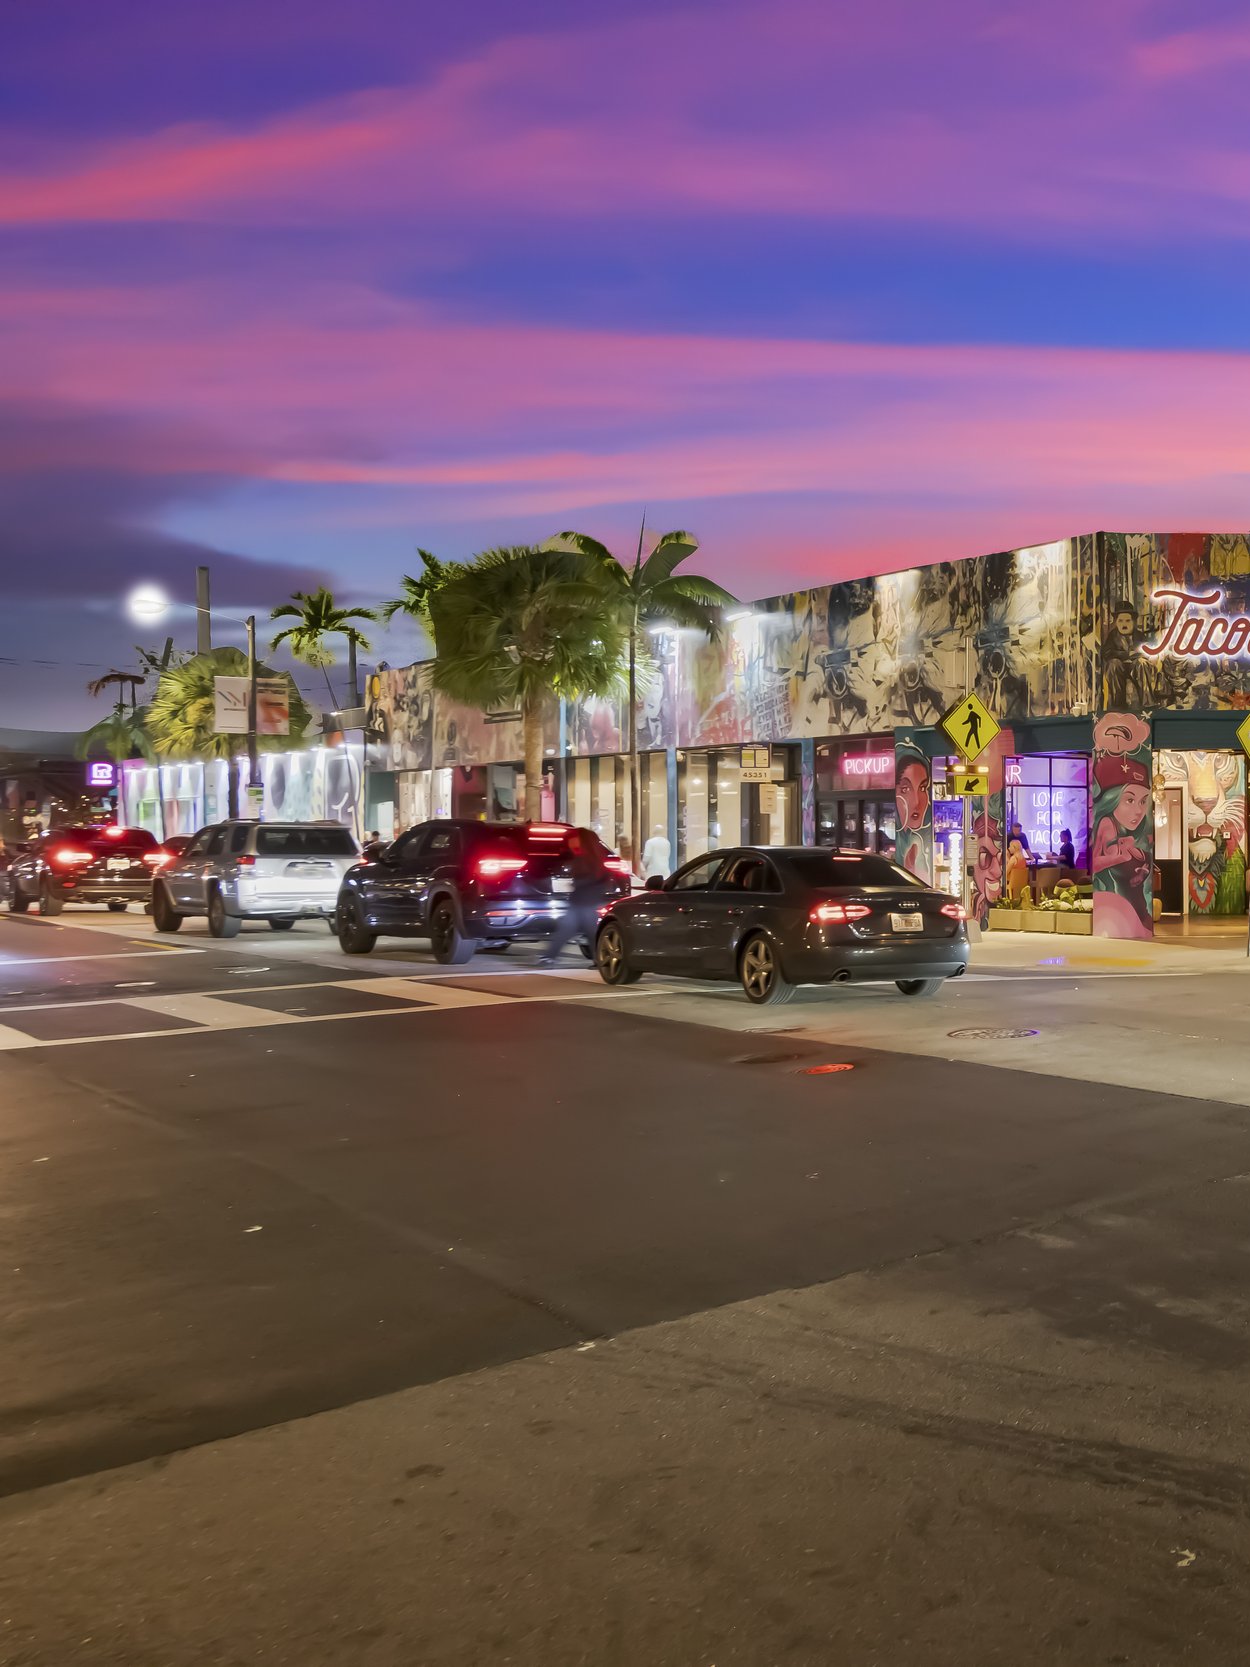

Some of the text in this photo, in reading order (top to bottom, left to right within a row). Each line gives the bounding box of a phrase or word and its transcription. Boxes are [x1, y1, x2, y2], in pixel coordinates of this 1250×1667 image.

[844, 756, 890, 775] PICKUP
[1032, 791, 1064, 807] LOVE
[1036, 811, 1062, 825] FOR
[1028, 829, 1061, 845] TACO
